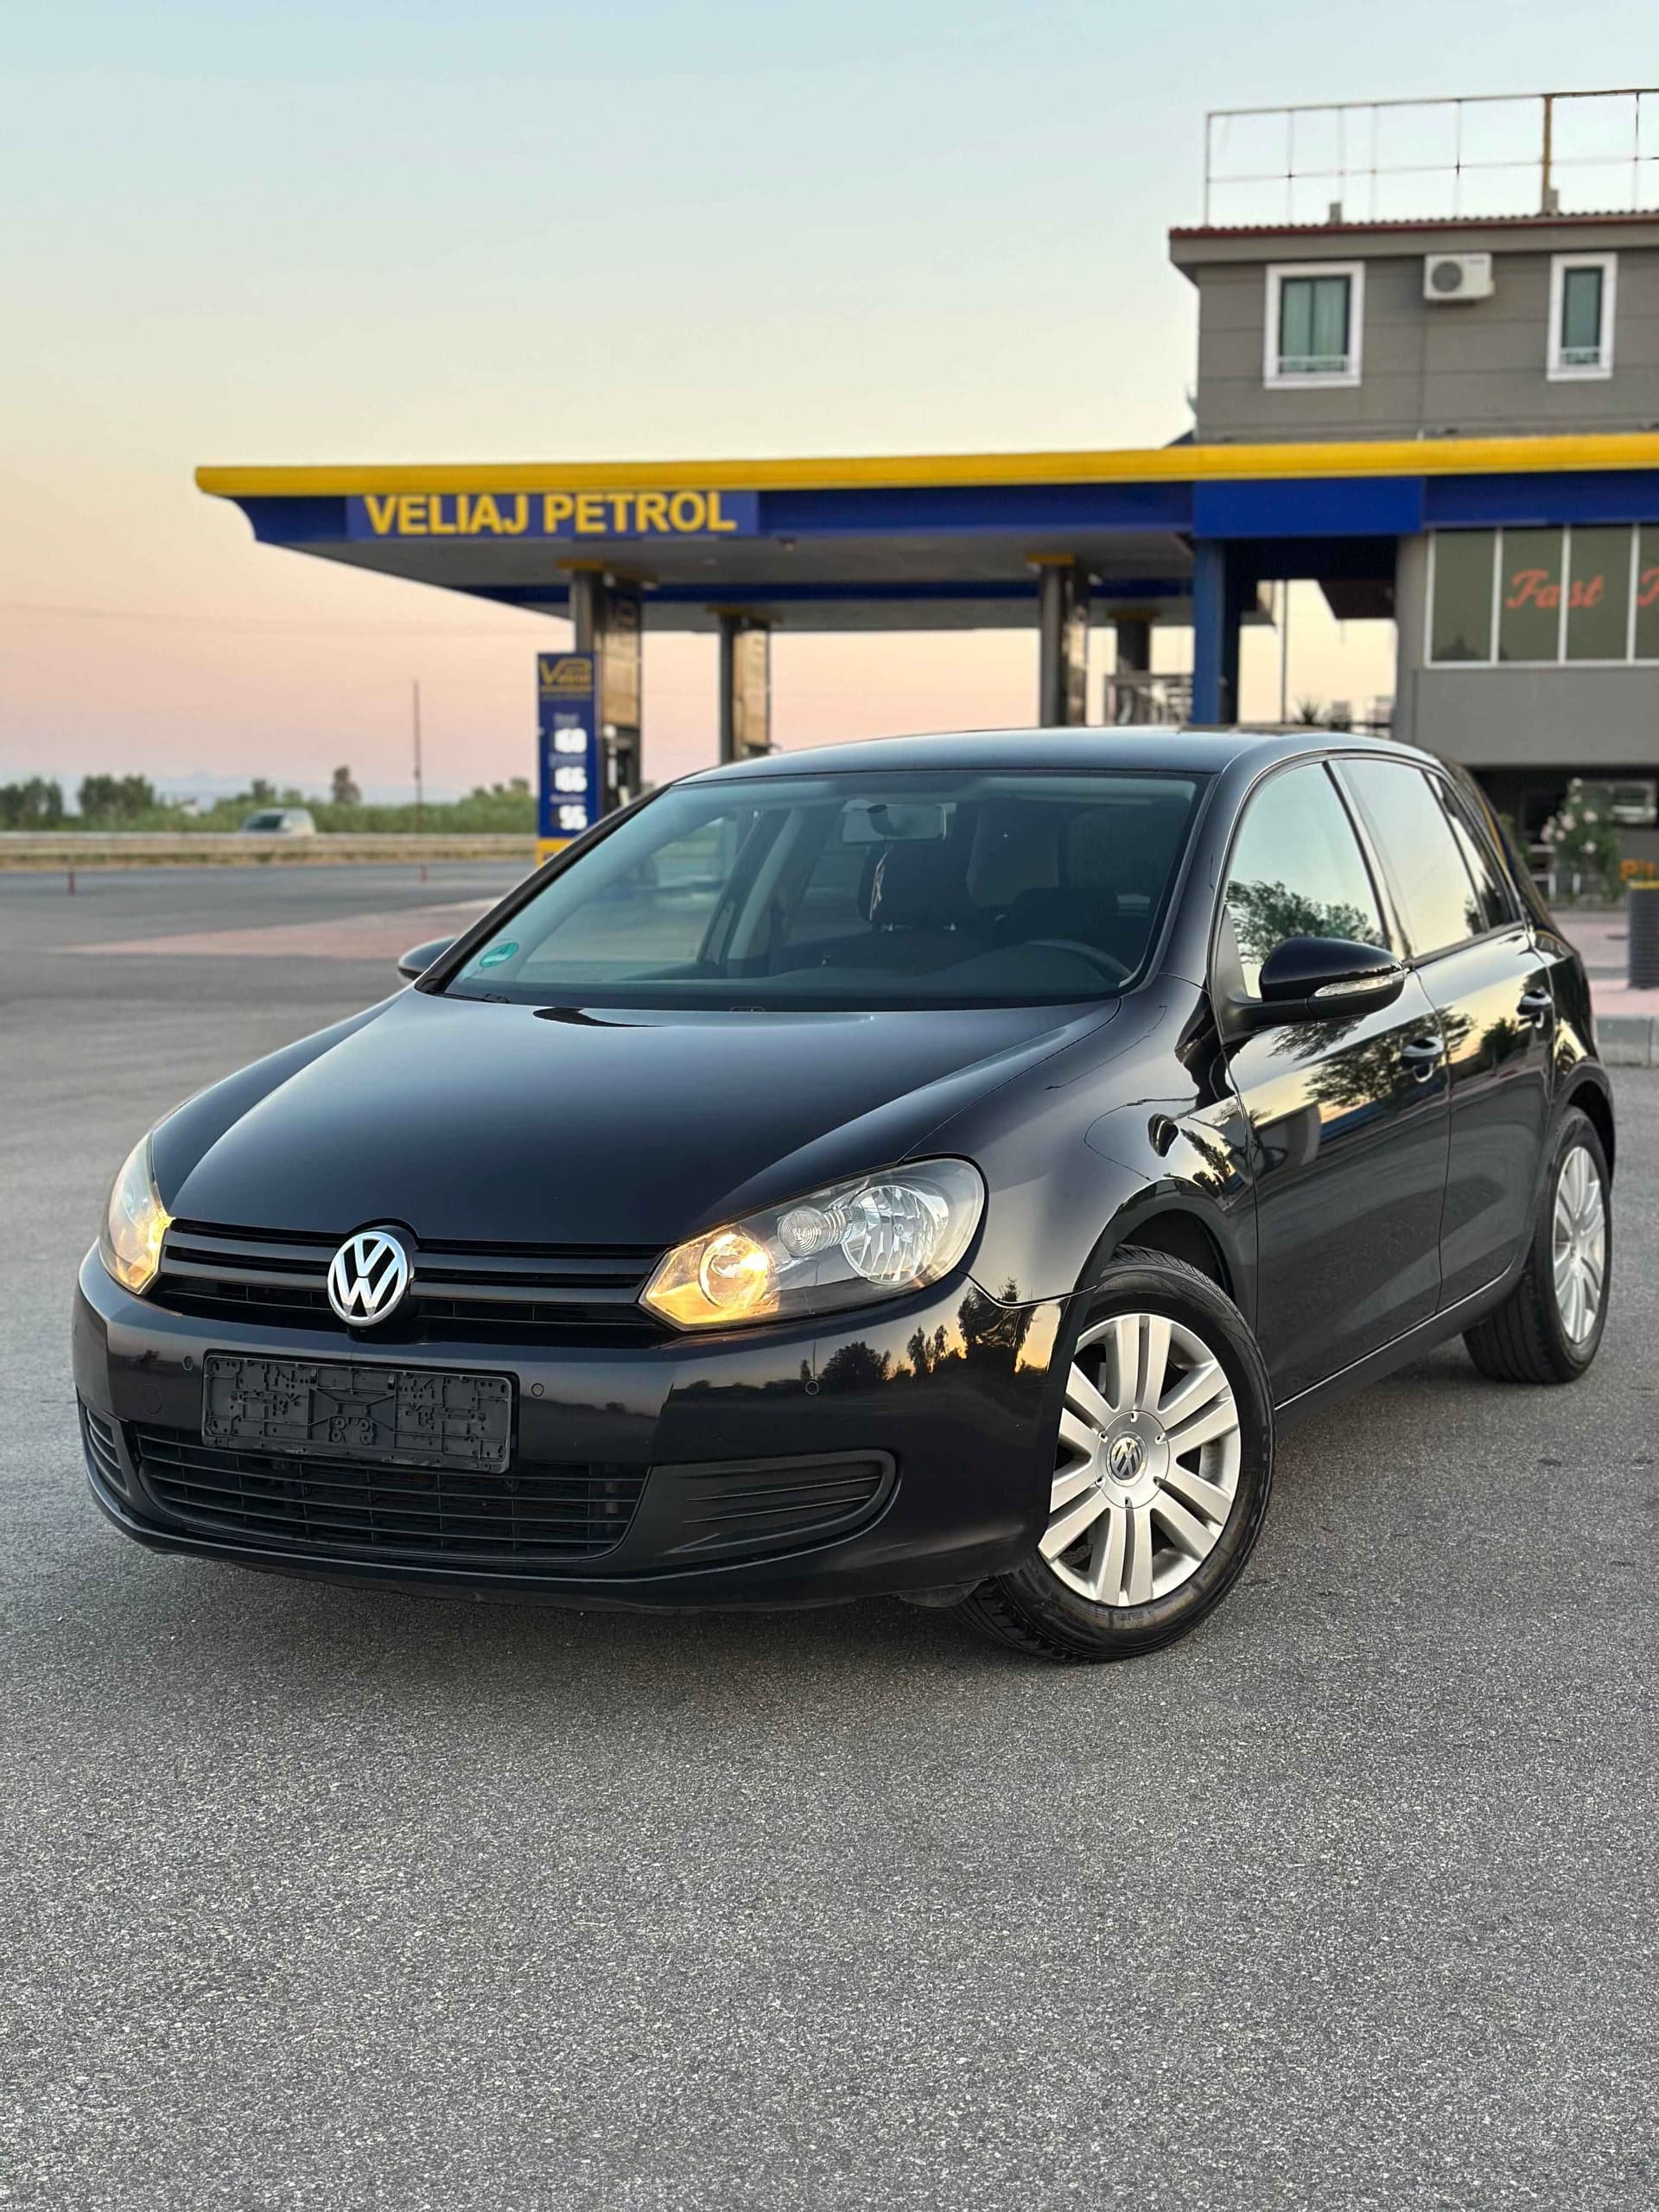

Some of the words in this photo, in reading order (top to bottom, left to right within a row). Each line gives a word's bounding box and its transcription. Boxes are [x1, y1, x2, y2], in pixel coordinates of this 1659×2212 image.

[364, 494, 529, 534] VELIAJ
[543, 492, 737, 534] PETROL
[1505, 568, 1605, 608] Fast
[330, 1233, 406, 1324] VW
